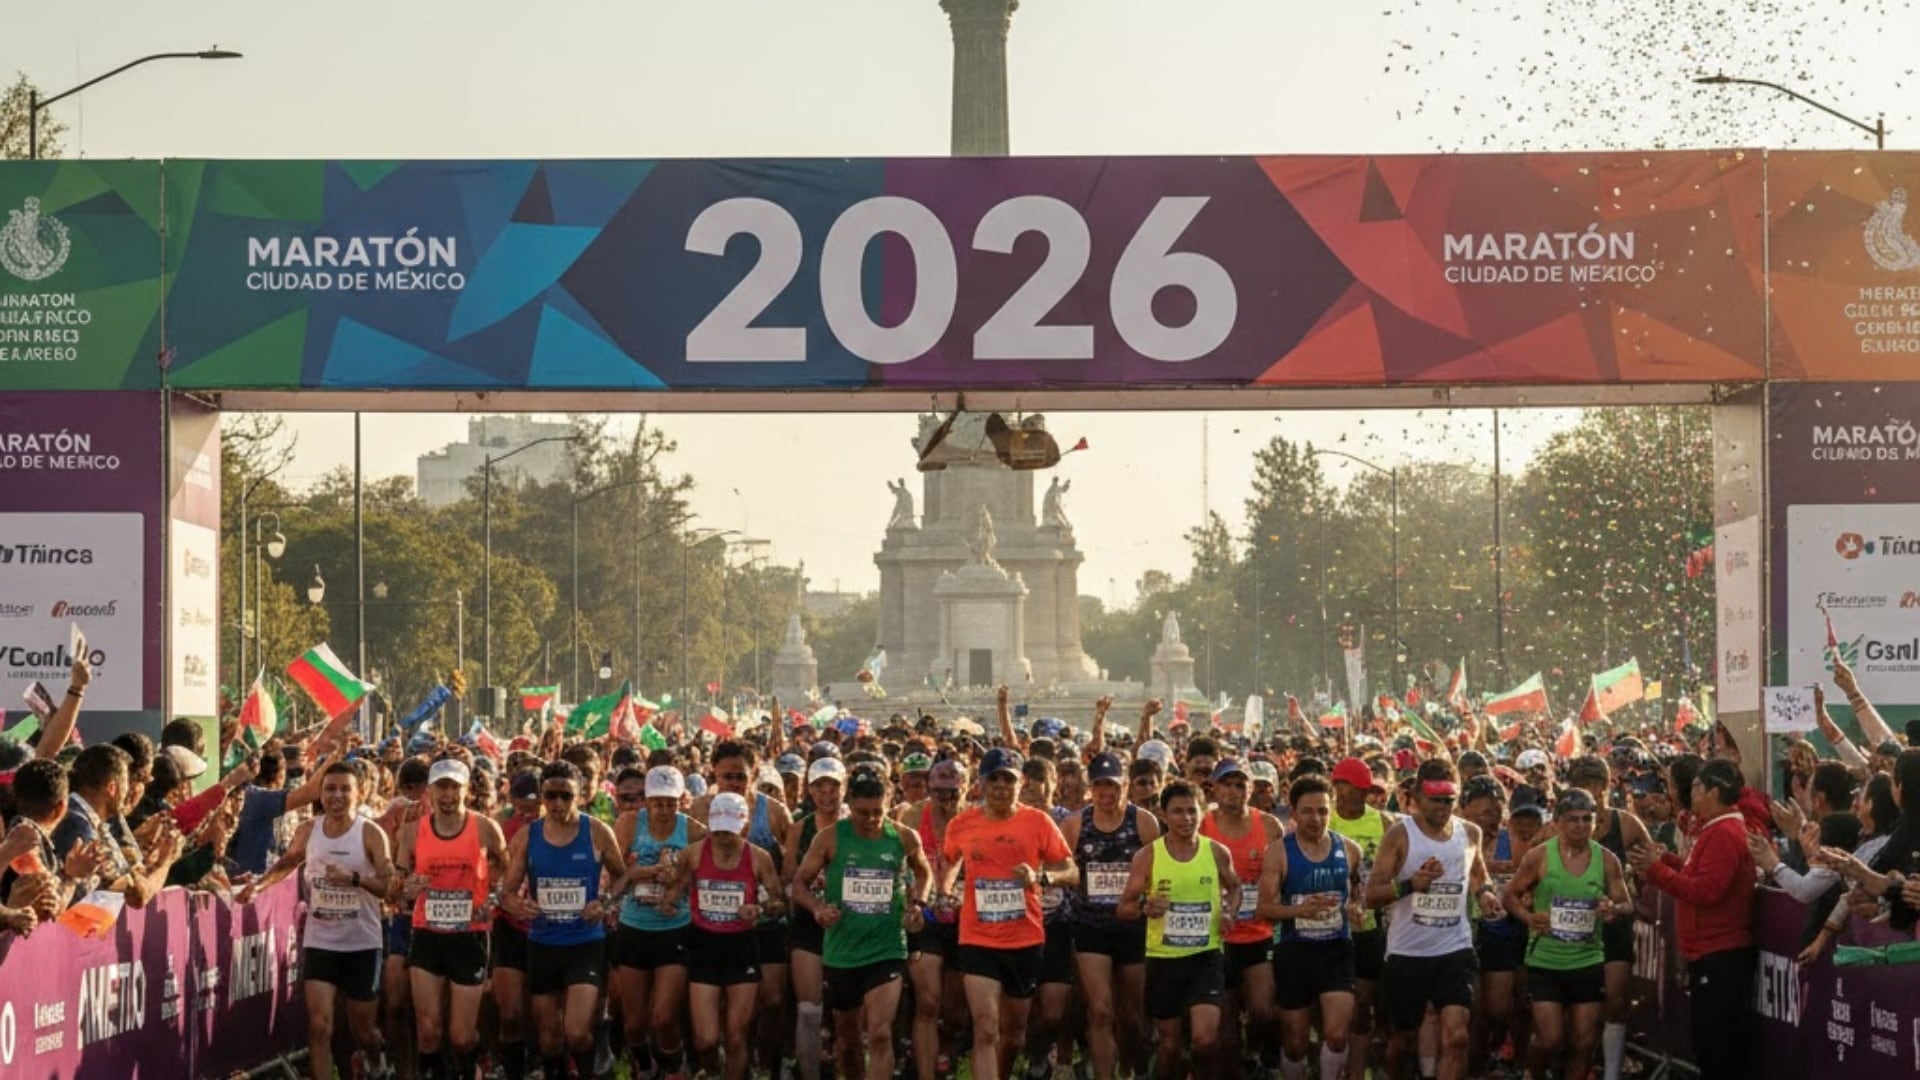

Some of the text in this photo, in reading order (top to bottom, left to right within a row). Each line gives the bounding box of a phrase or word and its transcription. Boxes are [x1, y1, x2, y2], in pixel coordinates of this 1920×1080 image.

[248, 226, 457, 268] MARATÓN
[1443, 222, 1635, 262] MARATÓN
[246, 271, 333, 291] CIUDAD
[338, 272, 369, 290] DE
[684, 194, 1238, 364] 2026
[1444, 265, 1529, 283] CIUDAD
[1534, 265, 1563, 282] DE
[21, 455, 45, 469] DE
